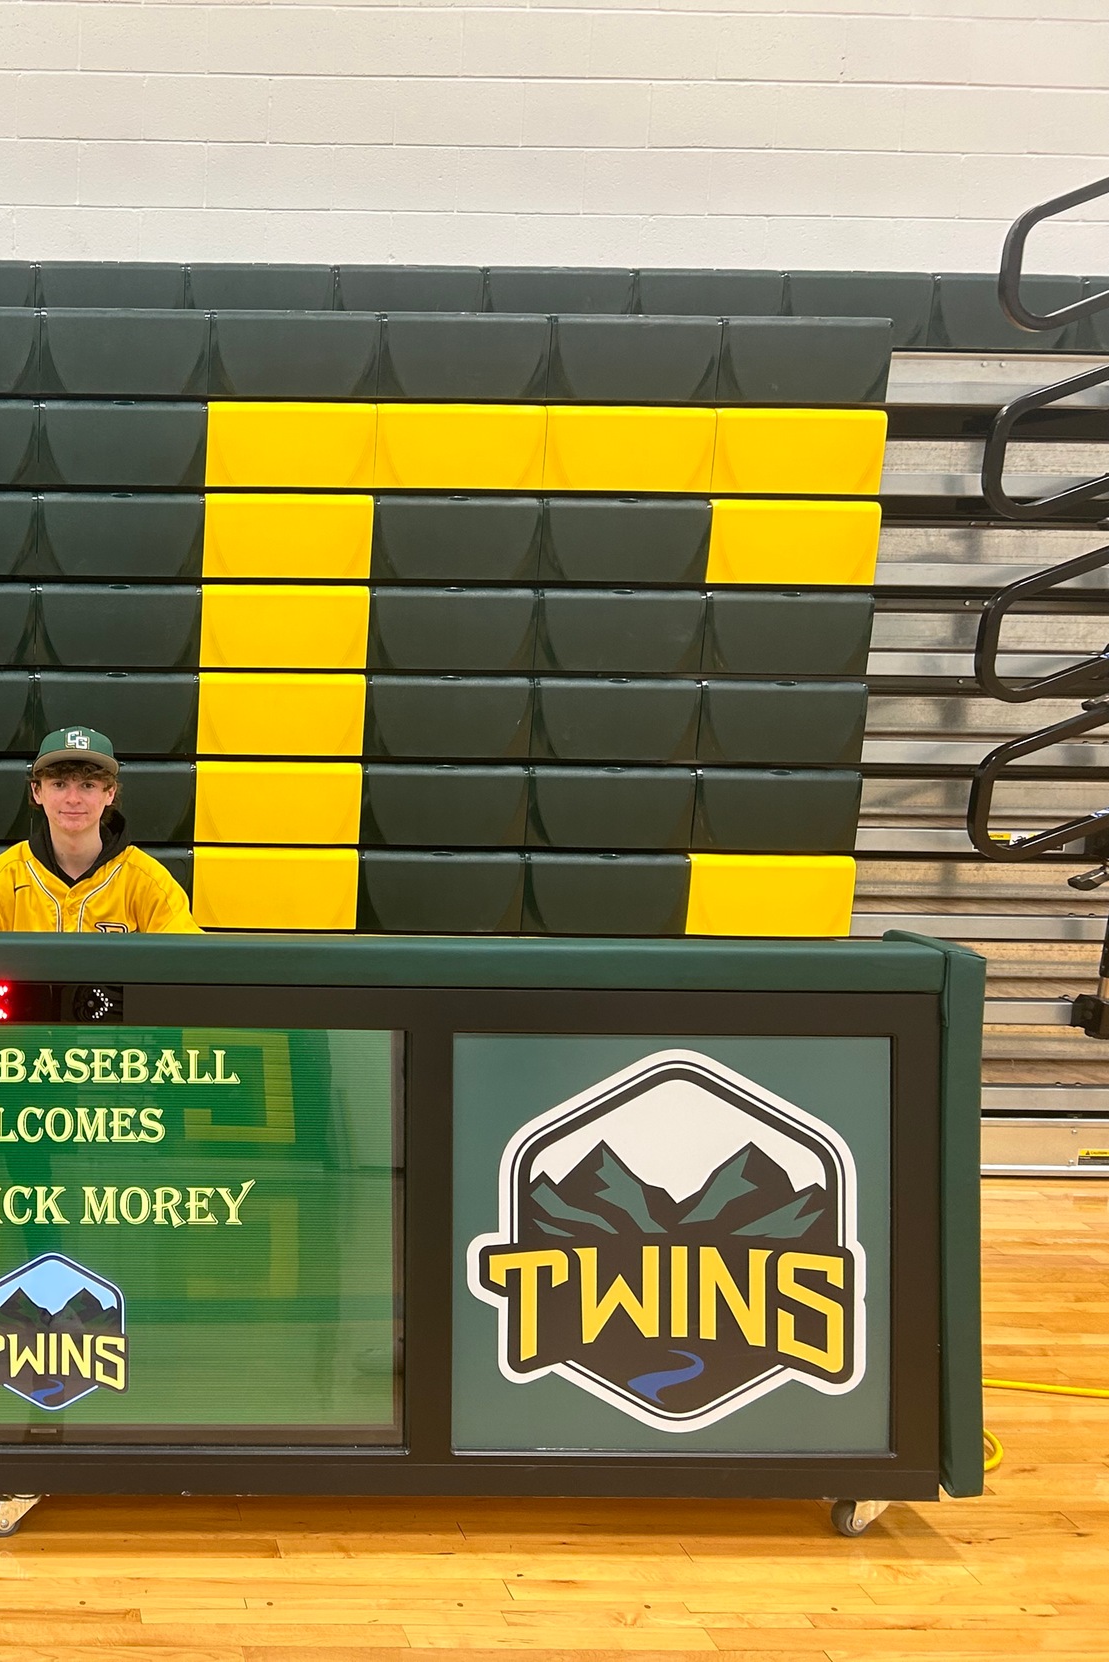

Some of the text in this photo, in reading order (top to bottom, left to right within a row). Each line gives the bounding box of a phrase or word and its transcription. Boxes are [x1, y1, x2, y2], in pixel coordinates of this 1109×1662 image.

[66, 730, 90, 749] CG
[79, 1179, 256, 1229] MOREY
[489, 1245, 844, 1374] TWINS
